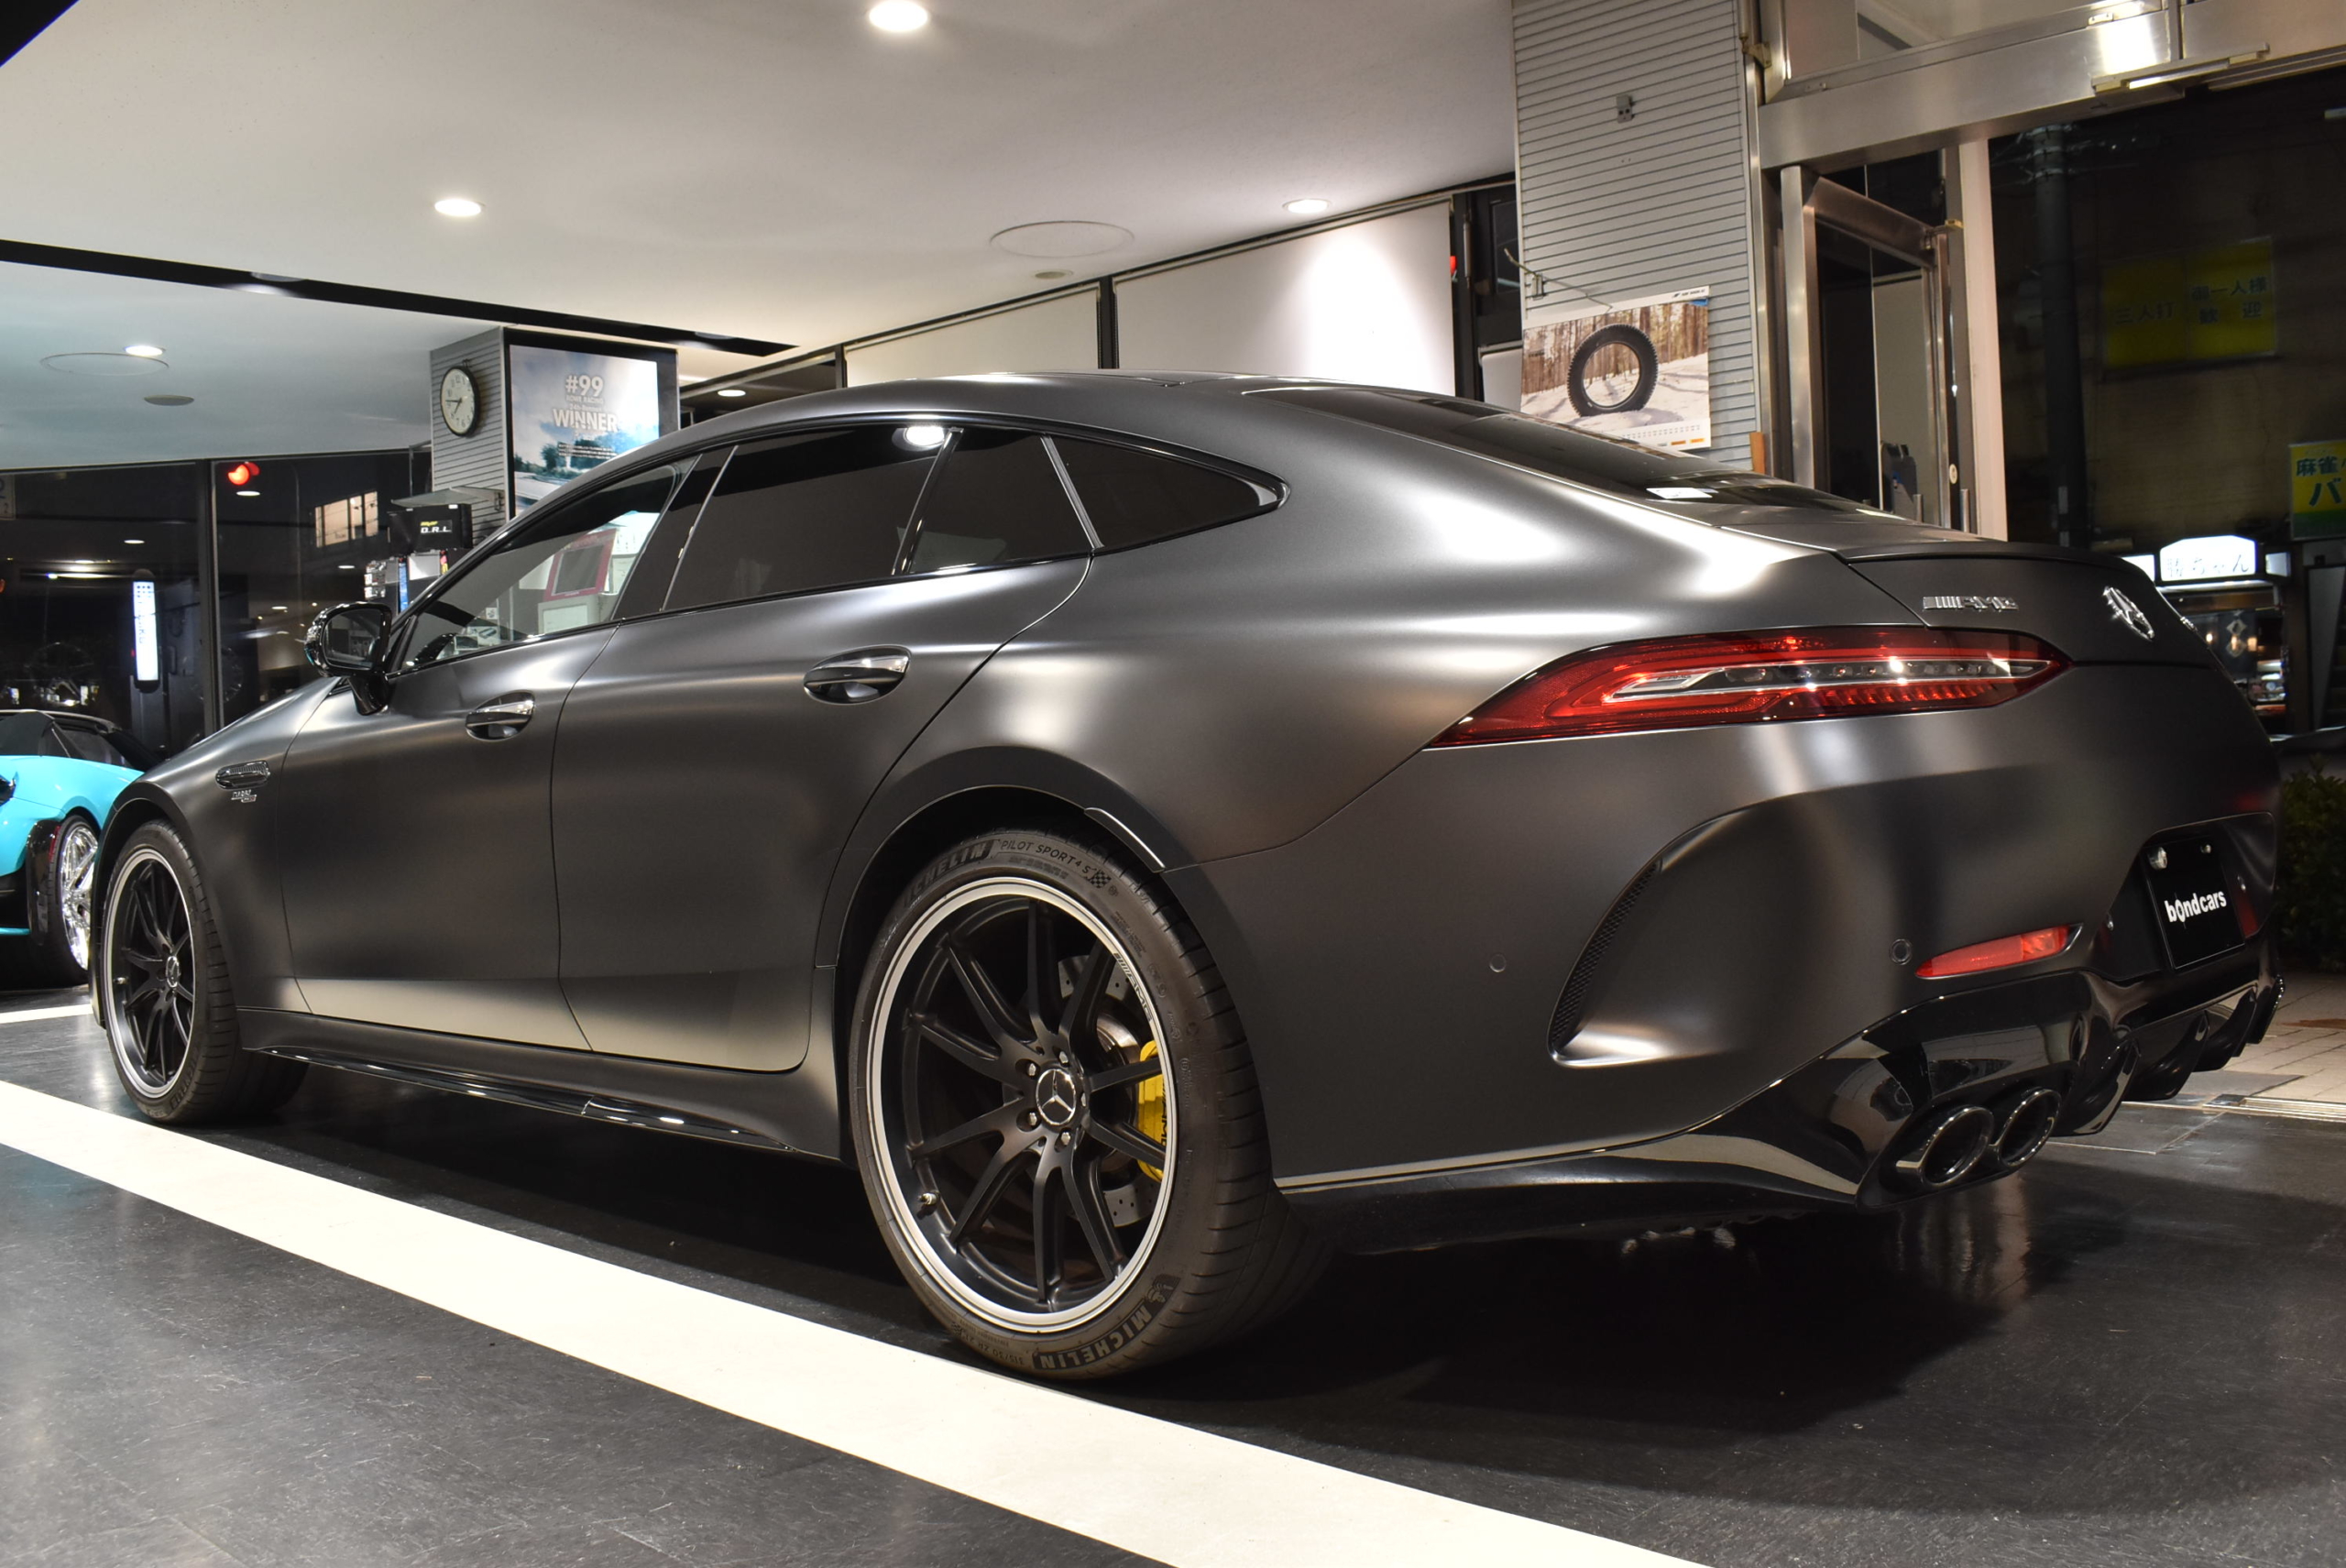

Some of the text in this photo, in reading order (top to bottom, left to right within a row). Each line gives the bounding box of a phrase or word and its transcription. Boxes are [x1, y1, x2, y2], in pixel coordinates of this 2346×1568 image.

[565, 374, 604, 396] #99
[553, 409, 619, 433] WINNER
[2297, 455, 2346, 476] 麻雀
[1001, 840, 1035, 851] PILOT
[1036, 844, 1077, 864] SPORT
[1082, 865, 1091, 874] S
[899, 840, 987, 910] ICHELIN
[1040, 1306, 1152, 1368] MICHELIN
